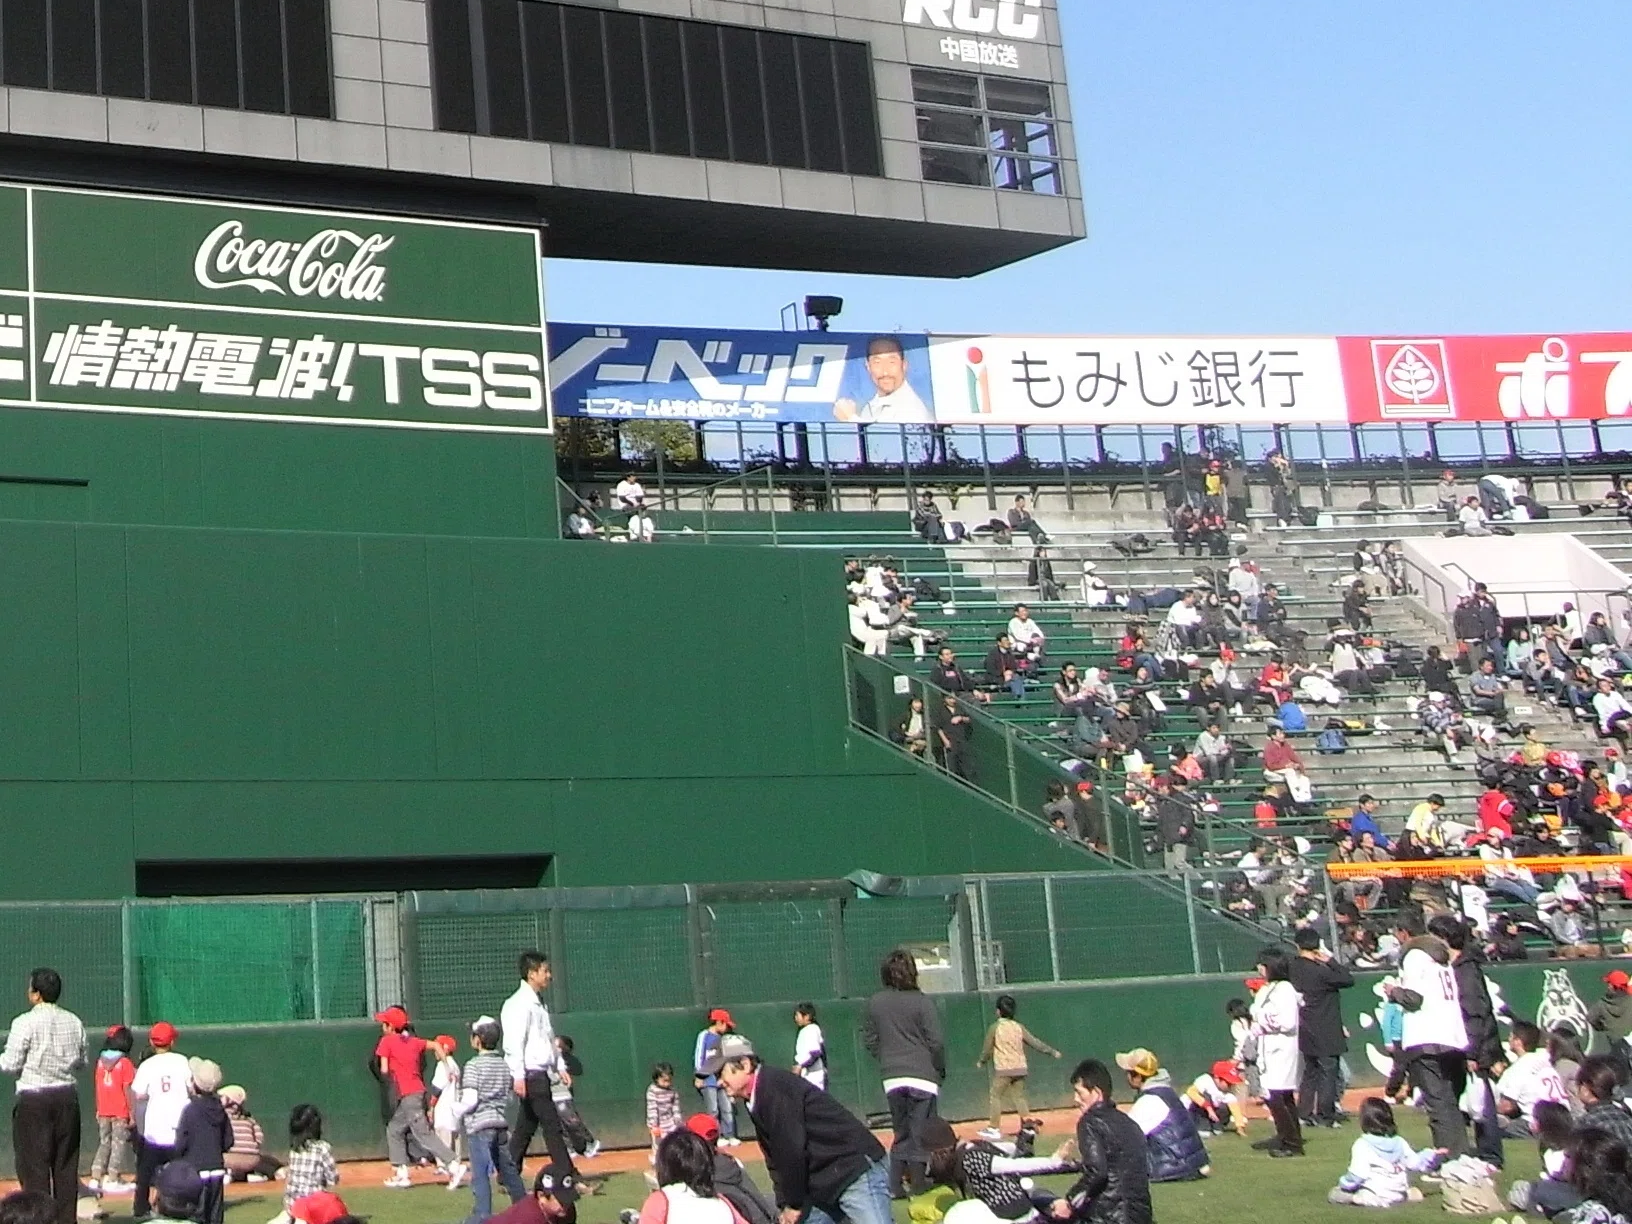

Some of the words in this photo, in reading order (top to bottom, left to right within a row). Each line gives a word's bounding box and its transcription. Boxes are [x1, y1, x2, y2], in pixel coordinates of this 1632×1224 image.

[940, 36, 1019, 69] 中国放送
[194, 220, 395, 301] Coca-Cola
[1011, 349, 1304, 410] もみじ銀行
